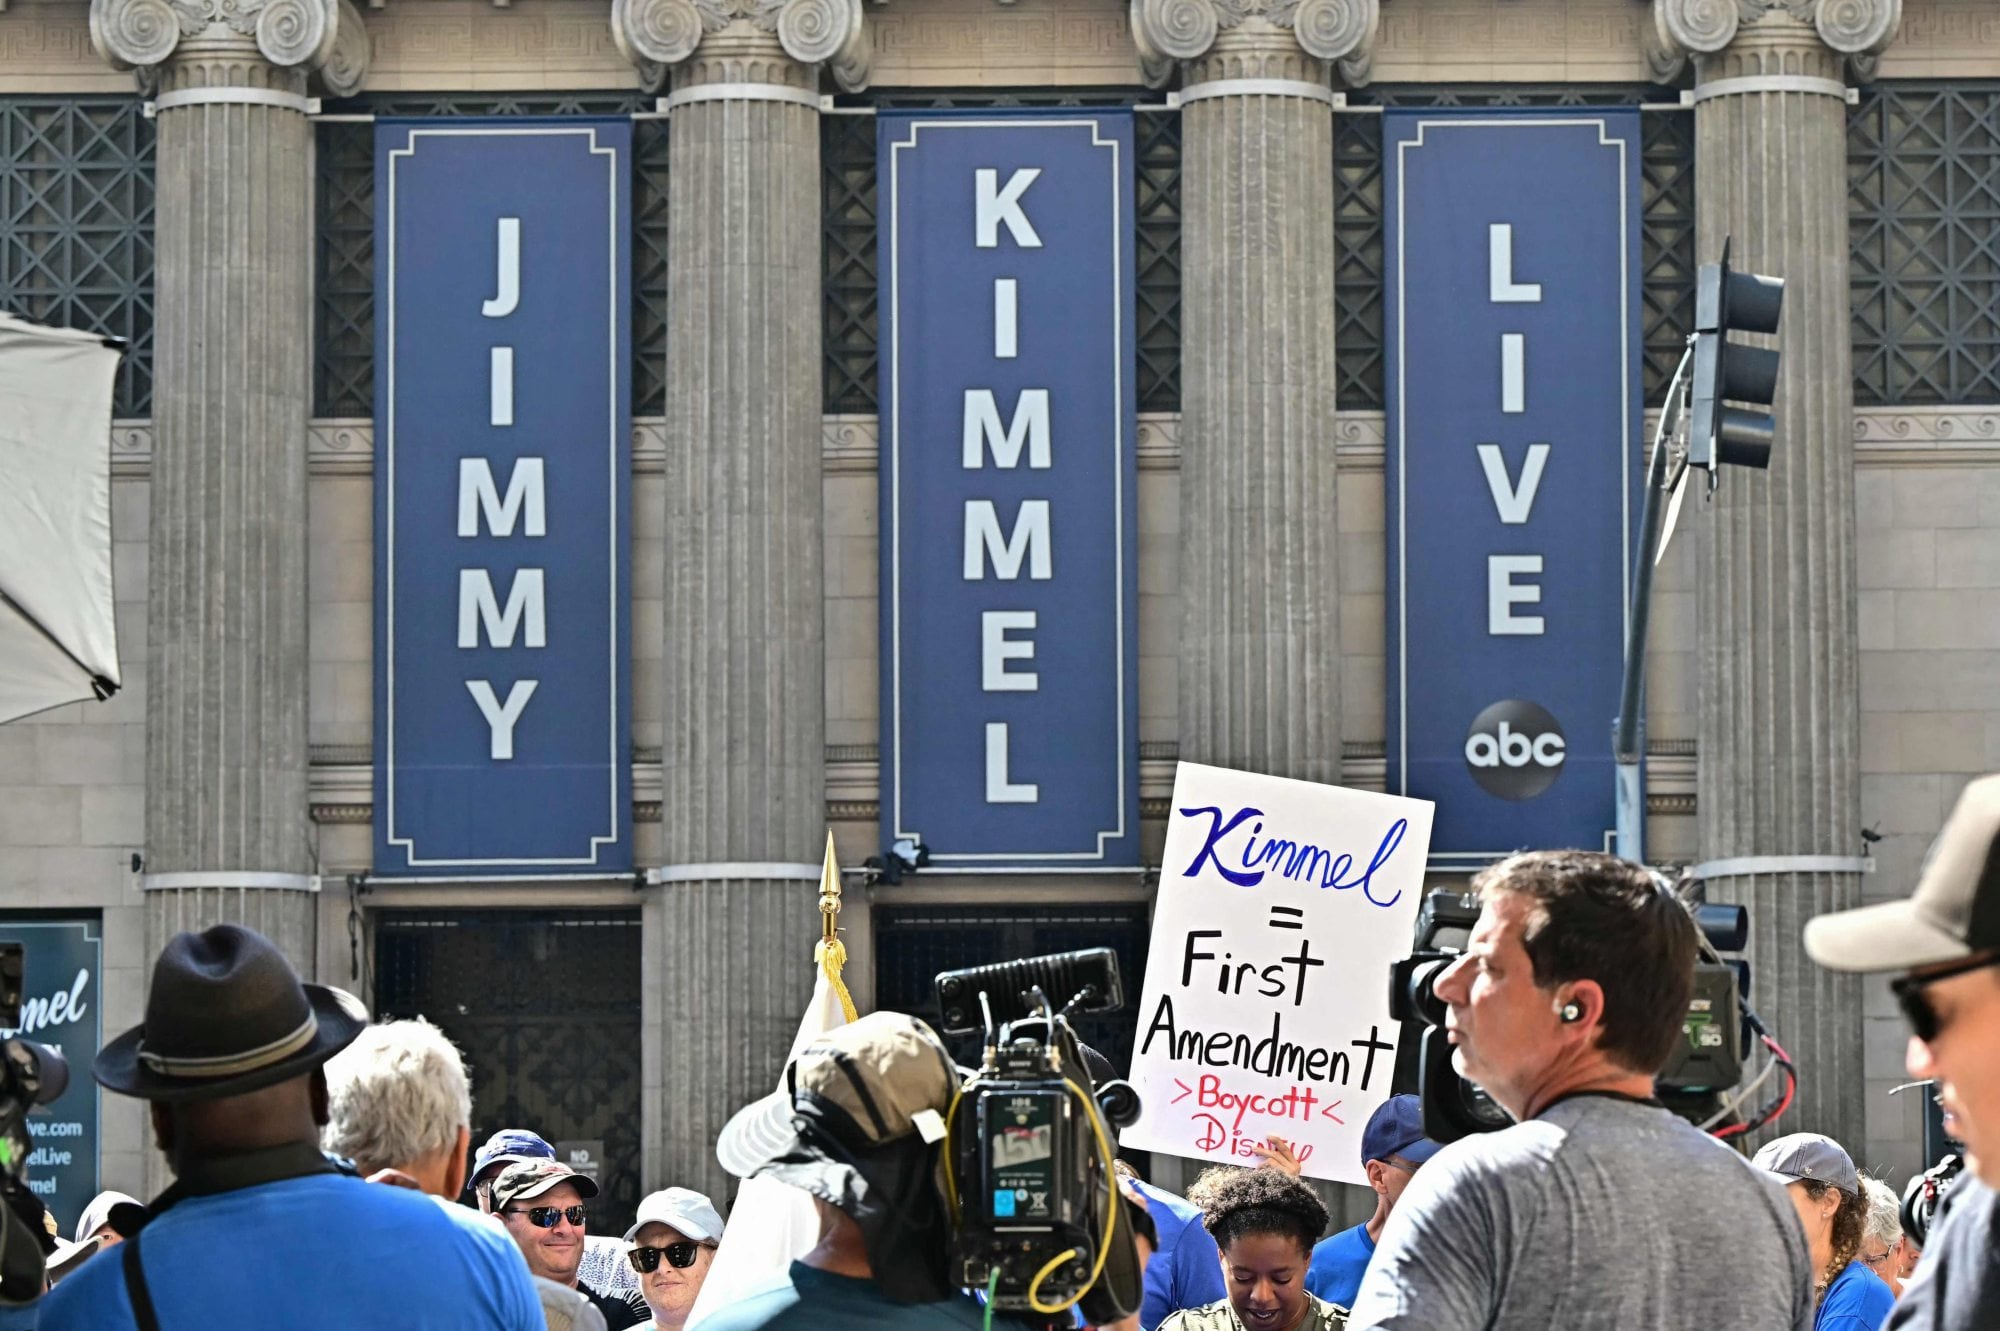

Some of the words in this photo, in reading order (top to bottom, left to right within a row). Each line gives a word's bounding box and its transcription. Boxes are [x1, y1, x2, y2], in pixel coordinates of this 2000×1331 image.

[1477, 223, 1551, 635] LIVE
[458, 217, 546, 760] JIMMY
[963, 168, 1052, 803] KIMMEL
[1465, 721, 1566, 767] abc
[1179, 806, 1408, 908] Kimmel
[0, 968, 89, 1039] mel
[1182, 931, 1325, 1006] First
[1141, 994, 1394, 1091] Amendment
[570, 1149, 589, 1163] NO
[1192, 1113, 1314, 1161] Disy
